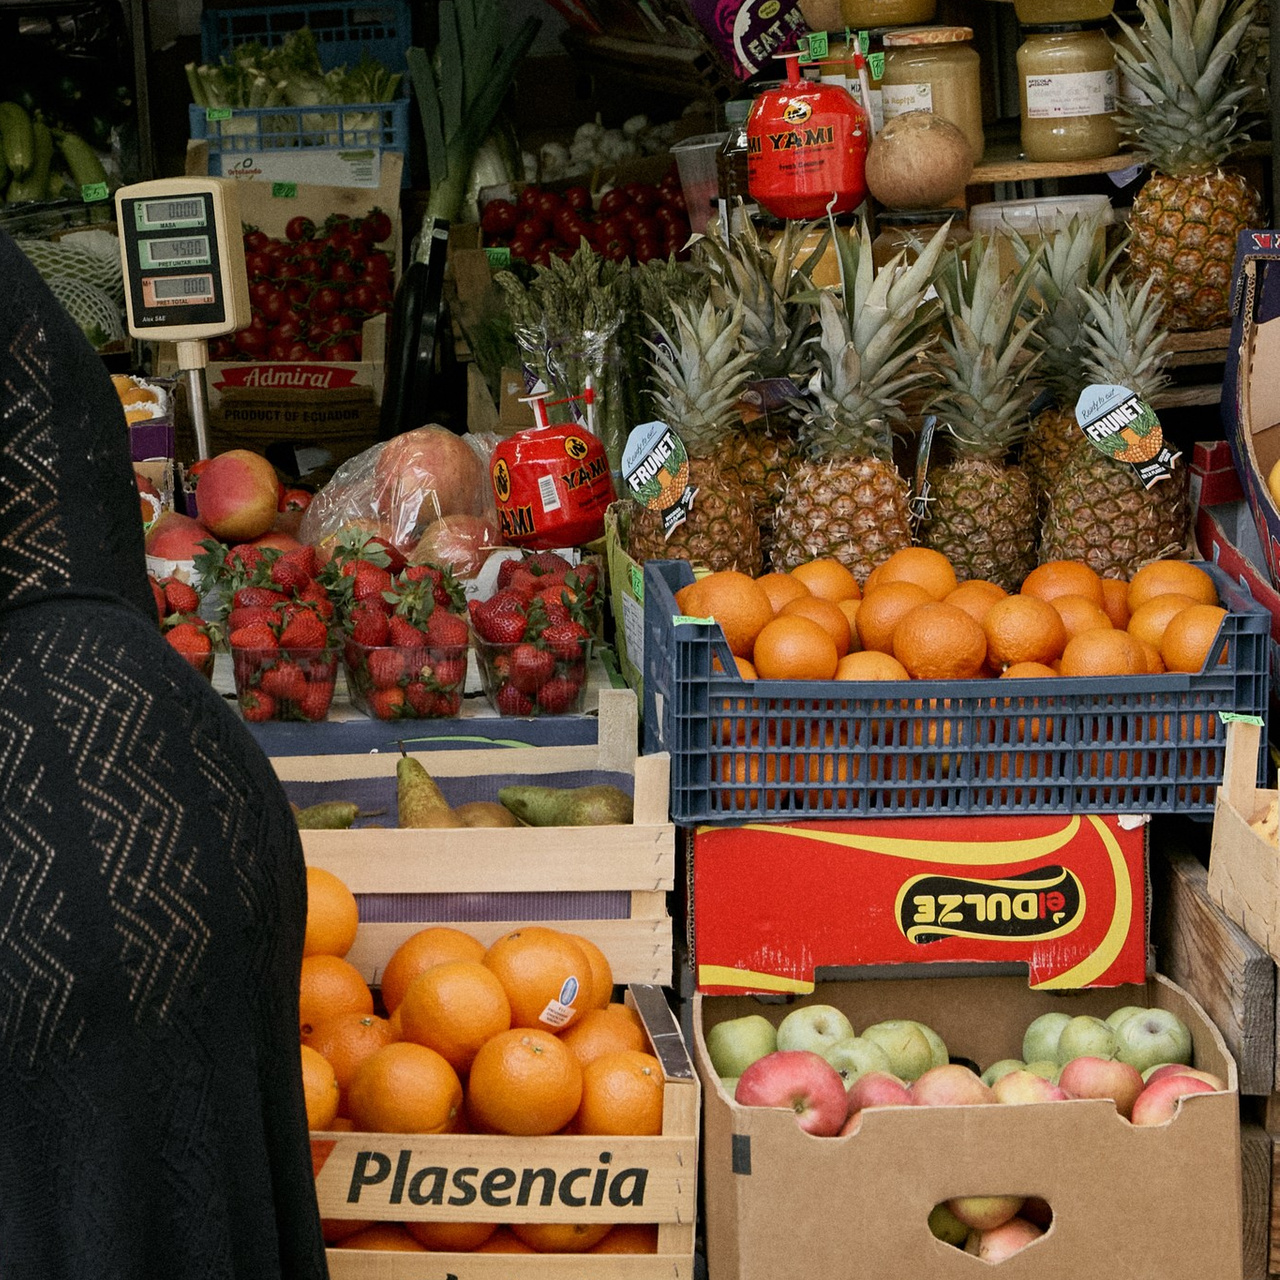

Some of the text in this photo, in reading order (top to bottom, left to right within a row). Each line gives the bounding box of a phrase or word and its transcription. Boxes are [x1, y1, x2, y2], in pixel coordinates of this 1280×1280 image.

[747, 20, 786, 61] EAT
[768, 125, 835, 152] YAMI
[172, 298, 189, 306] TOTAL
[243, 367, 334, 389] Admiral
[224, 409, 360, 422] PRODUCT OF ECUADOR
[1081, 403, 1100, 420] Ready
[1086, 397, 1145, 443] FRUNET
[561, 456, 607, 491] YAMI
[628, 431, 676, 493] FRUNET
[346, 1150, 649, 1207] Plasencia
